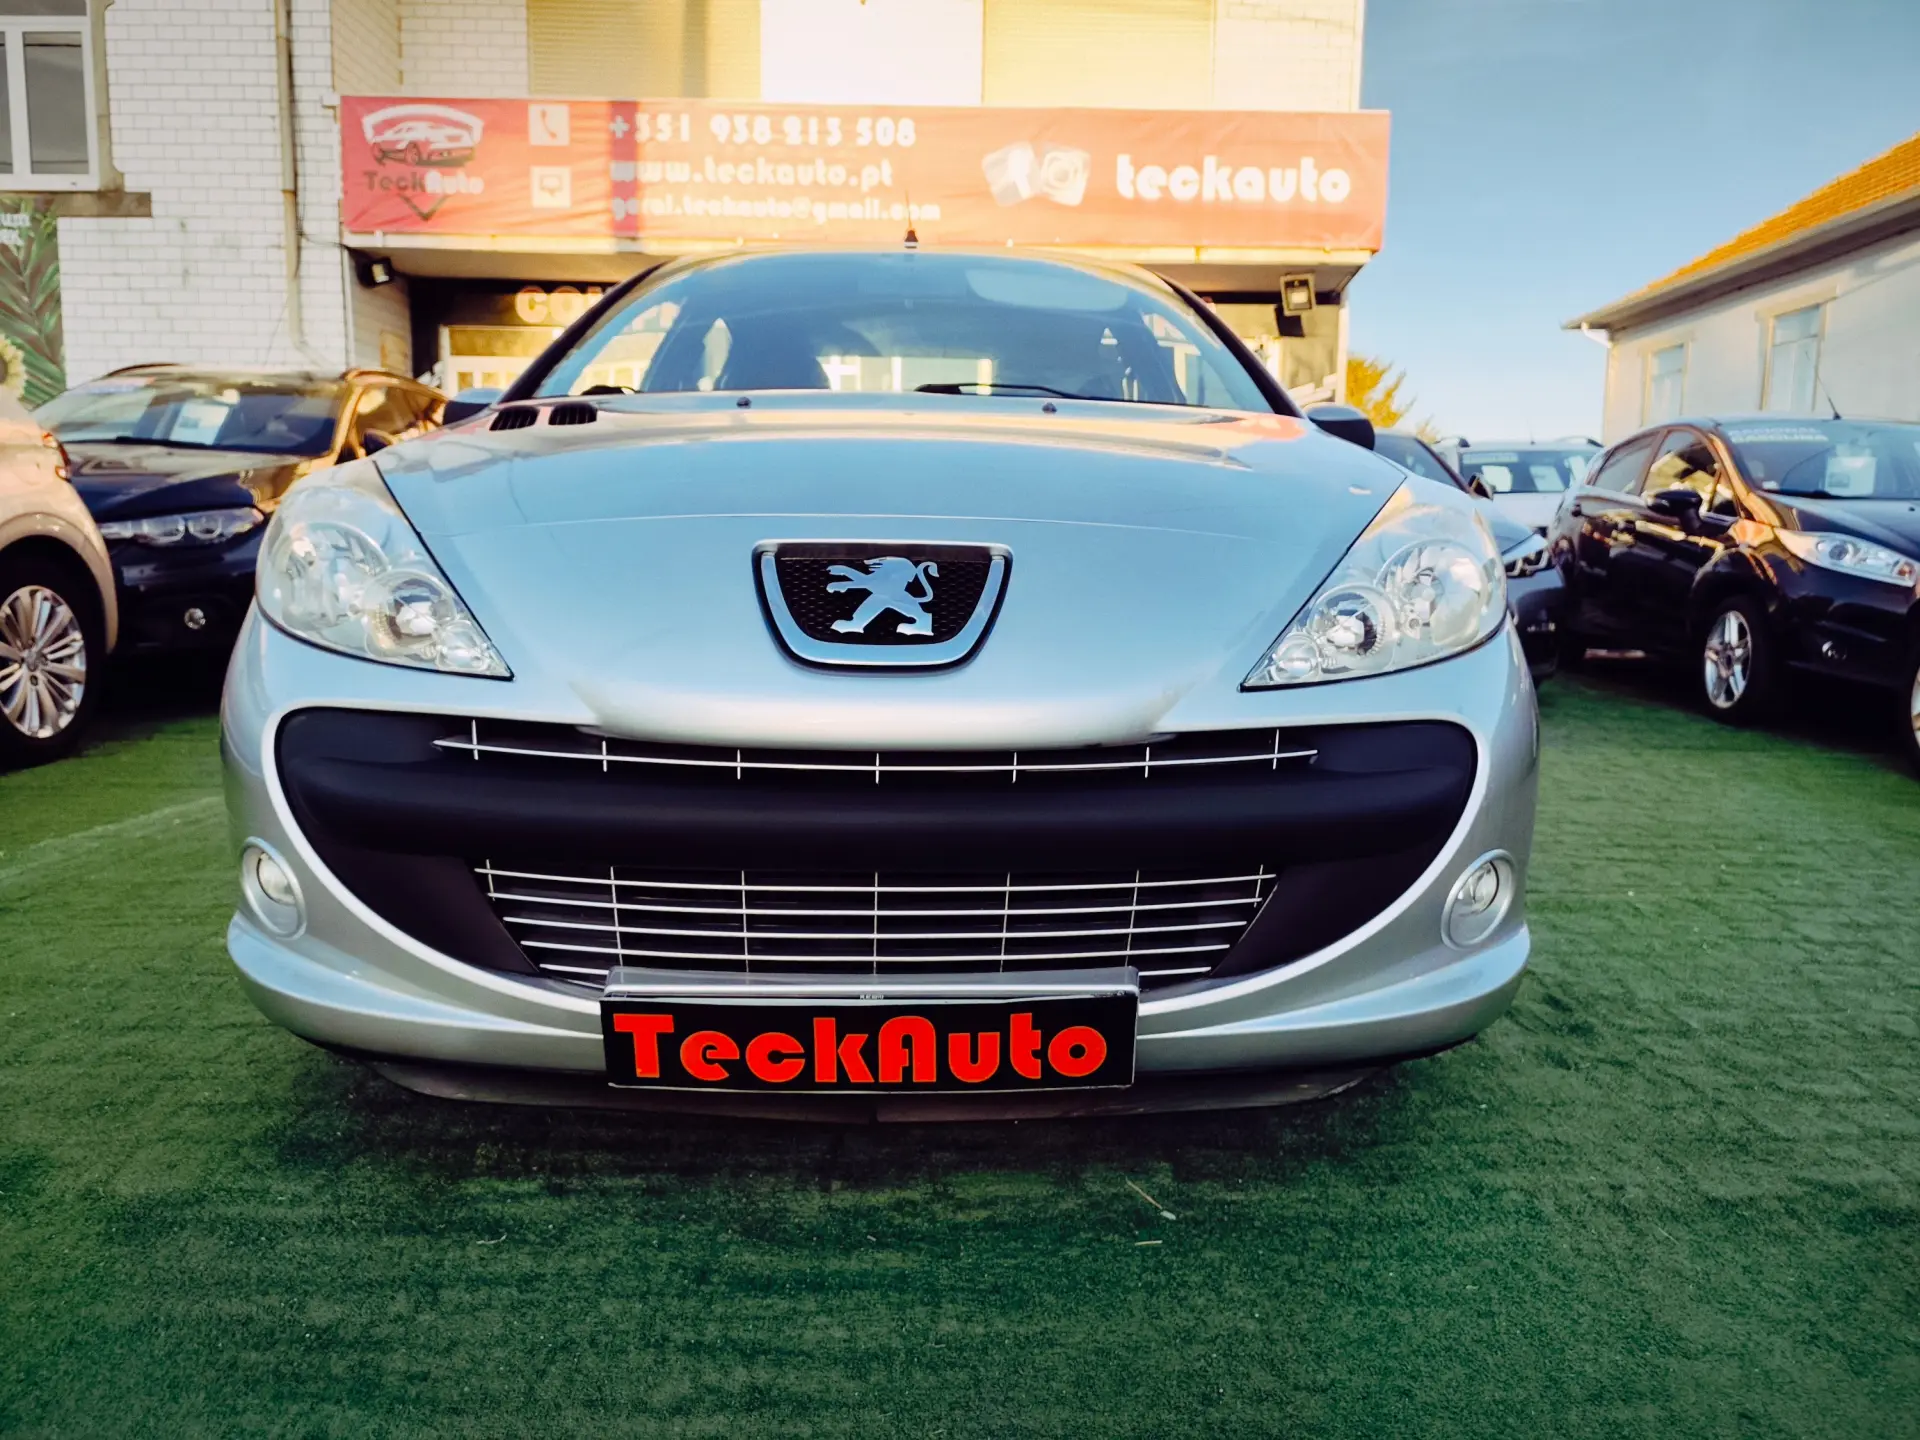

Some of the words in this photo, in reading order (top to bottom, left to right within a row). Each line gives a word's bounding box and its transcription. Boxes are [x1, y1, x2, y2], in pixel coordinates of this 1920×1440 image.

[609, 112, 690, 143] +351
[710, 113, 773, 146] 938
[782, 115, 843, 148] 213
[855, 116, 917, 148] 508
[362, 168, 485, 196] TeckAuto
[610, 155, 894, 194] www.teckauto.pt
[1115, 154, 1352, 205] teckauto
[612, 1012, 1108, 1084] TeckAuto
